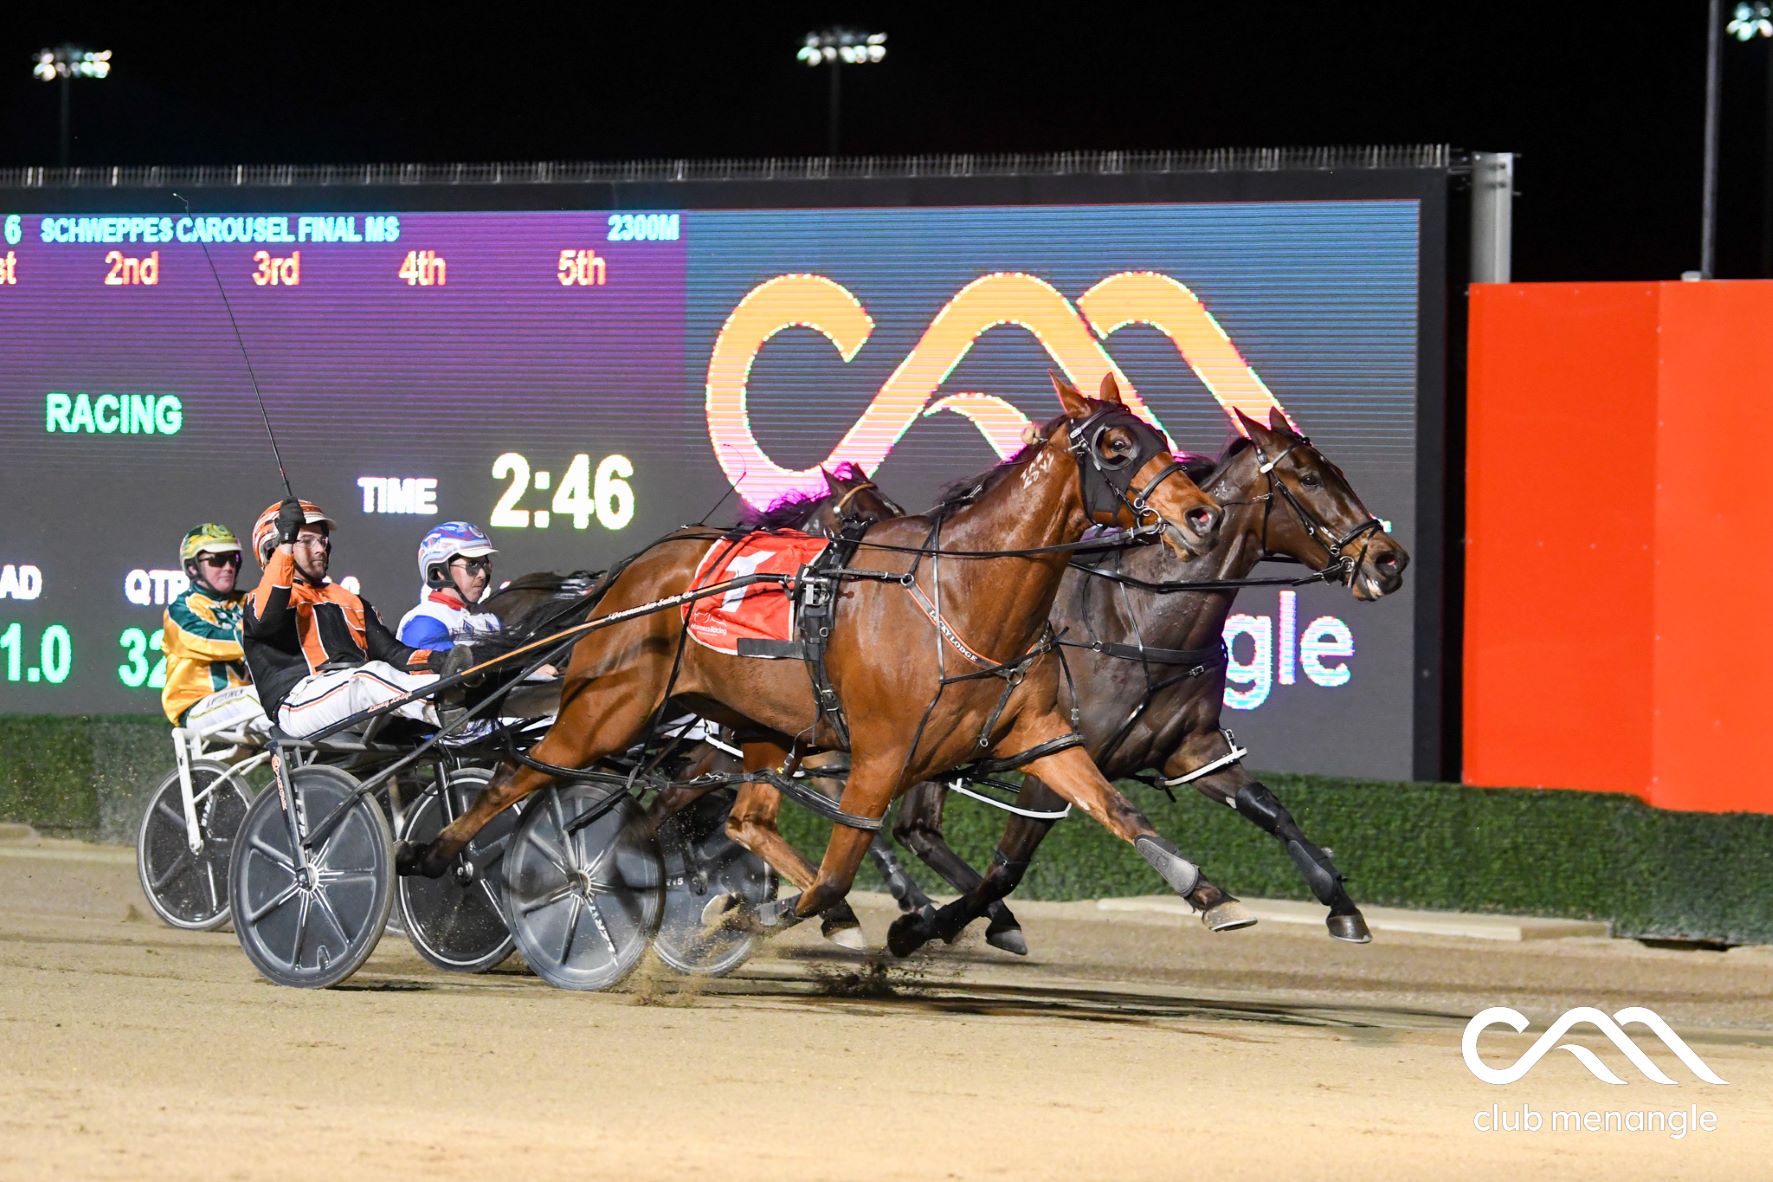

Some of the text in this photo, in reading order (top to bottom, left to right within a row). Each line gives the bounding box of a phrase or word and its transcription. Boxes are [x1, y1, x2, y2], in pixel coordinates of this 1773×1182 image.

[4, 214, 400, 245] 6 SCHWEPPES CAROUSEL FINAL MS
[607, 214, 680, 241] 2300M
[104, 250, 159, 285] 2nd
[252, 250, 300, 286] 3rd
[399, 250, 446, 286] 4th
[557, 249, 607, 286] 5th
[46, 393, 183, 435] RACING
[357, 476, 438, 515] TIME
[489, 452, 635, 530] 2:46
[0, 622, 72, 684] 1.0
[928, 609, 978, 662] LKY LODGE
